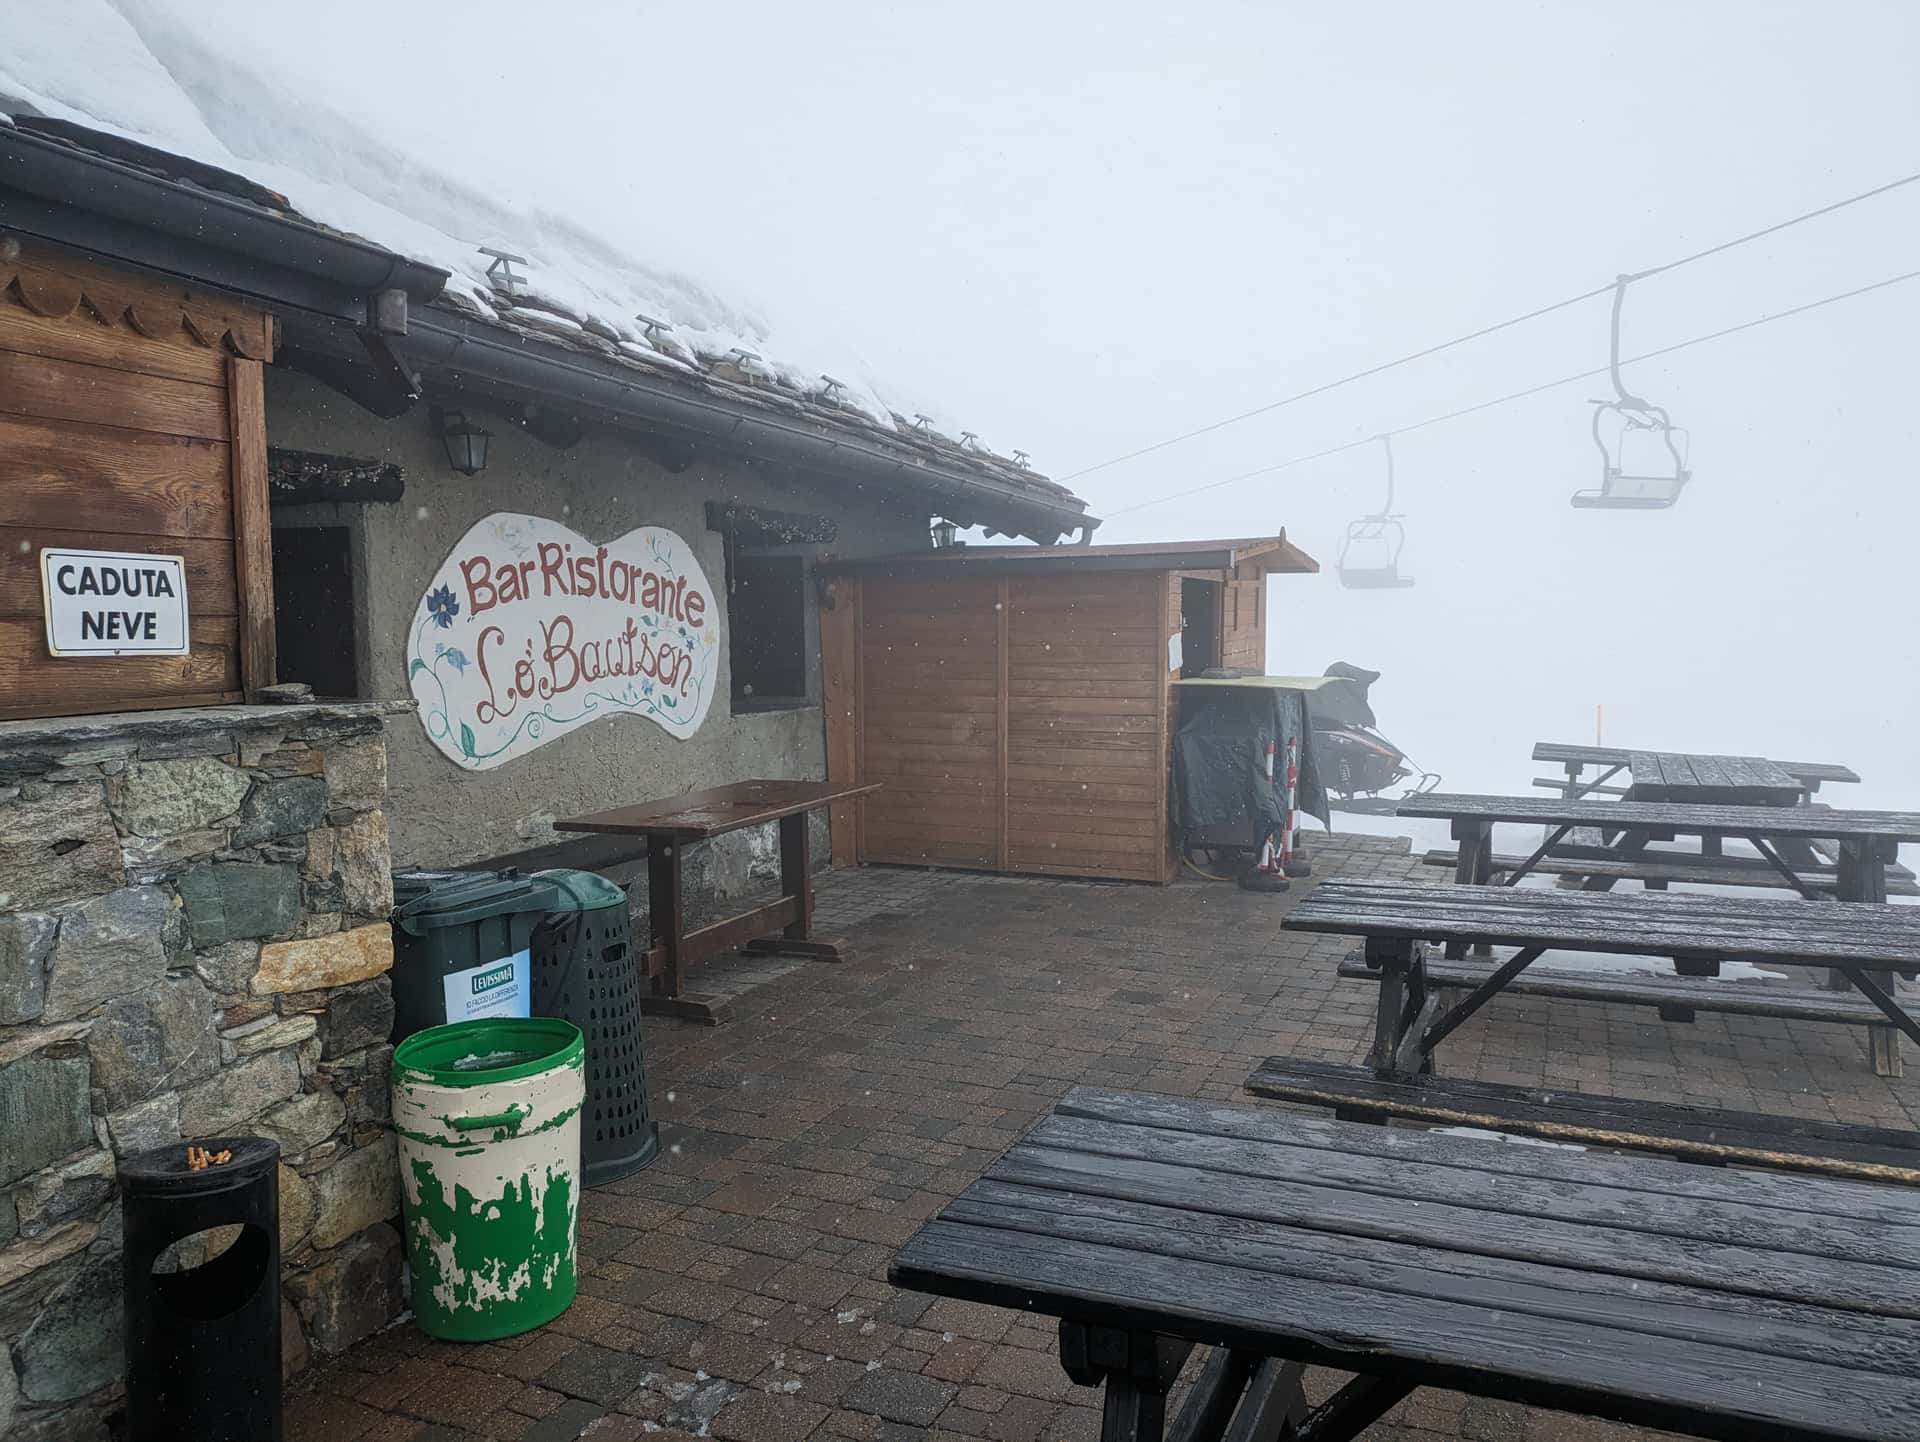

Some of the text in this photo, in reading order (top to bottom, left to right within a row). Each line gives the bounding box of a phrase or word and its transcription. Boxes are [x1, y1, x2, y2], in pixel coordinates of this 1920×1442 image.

[57, 564, 175, 598] CADUTA
[459, 542, 705, 628] Bar Ristorante
[81, 611, 157, 640] NEVE
[473, 965, 513, 992] LEVISSIMA
